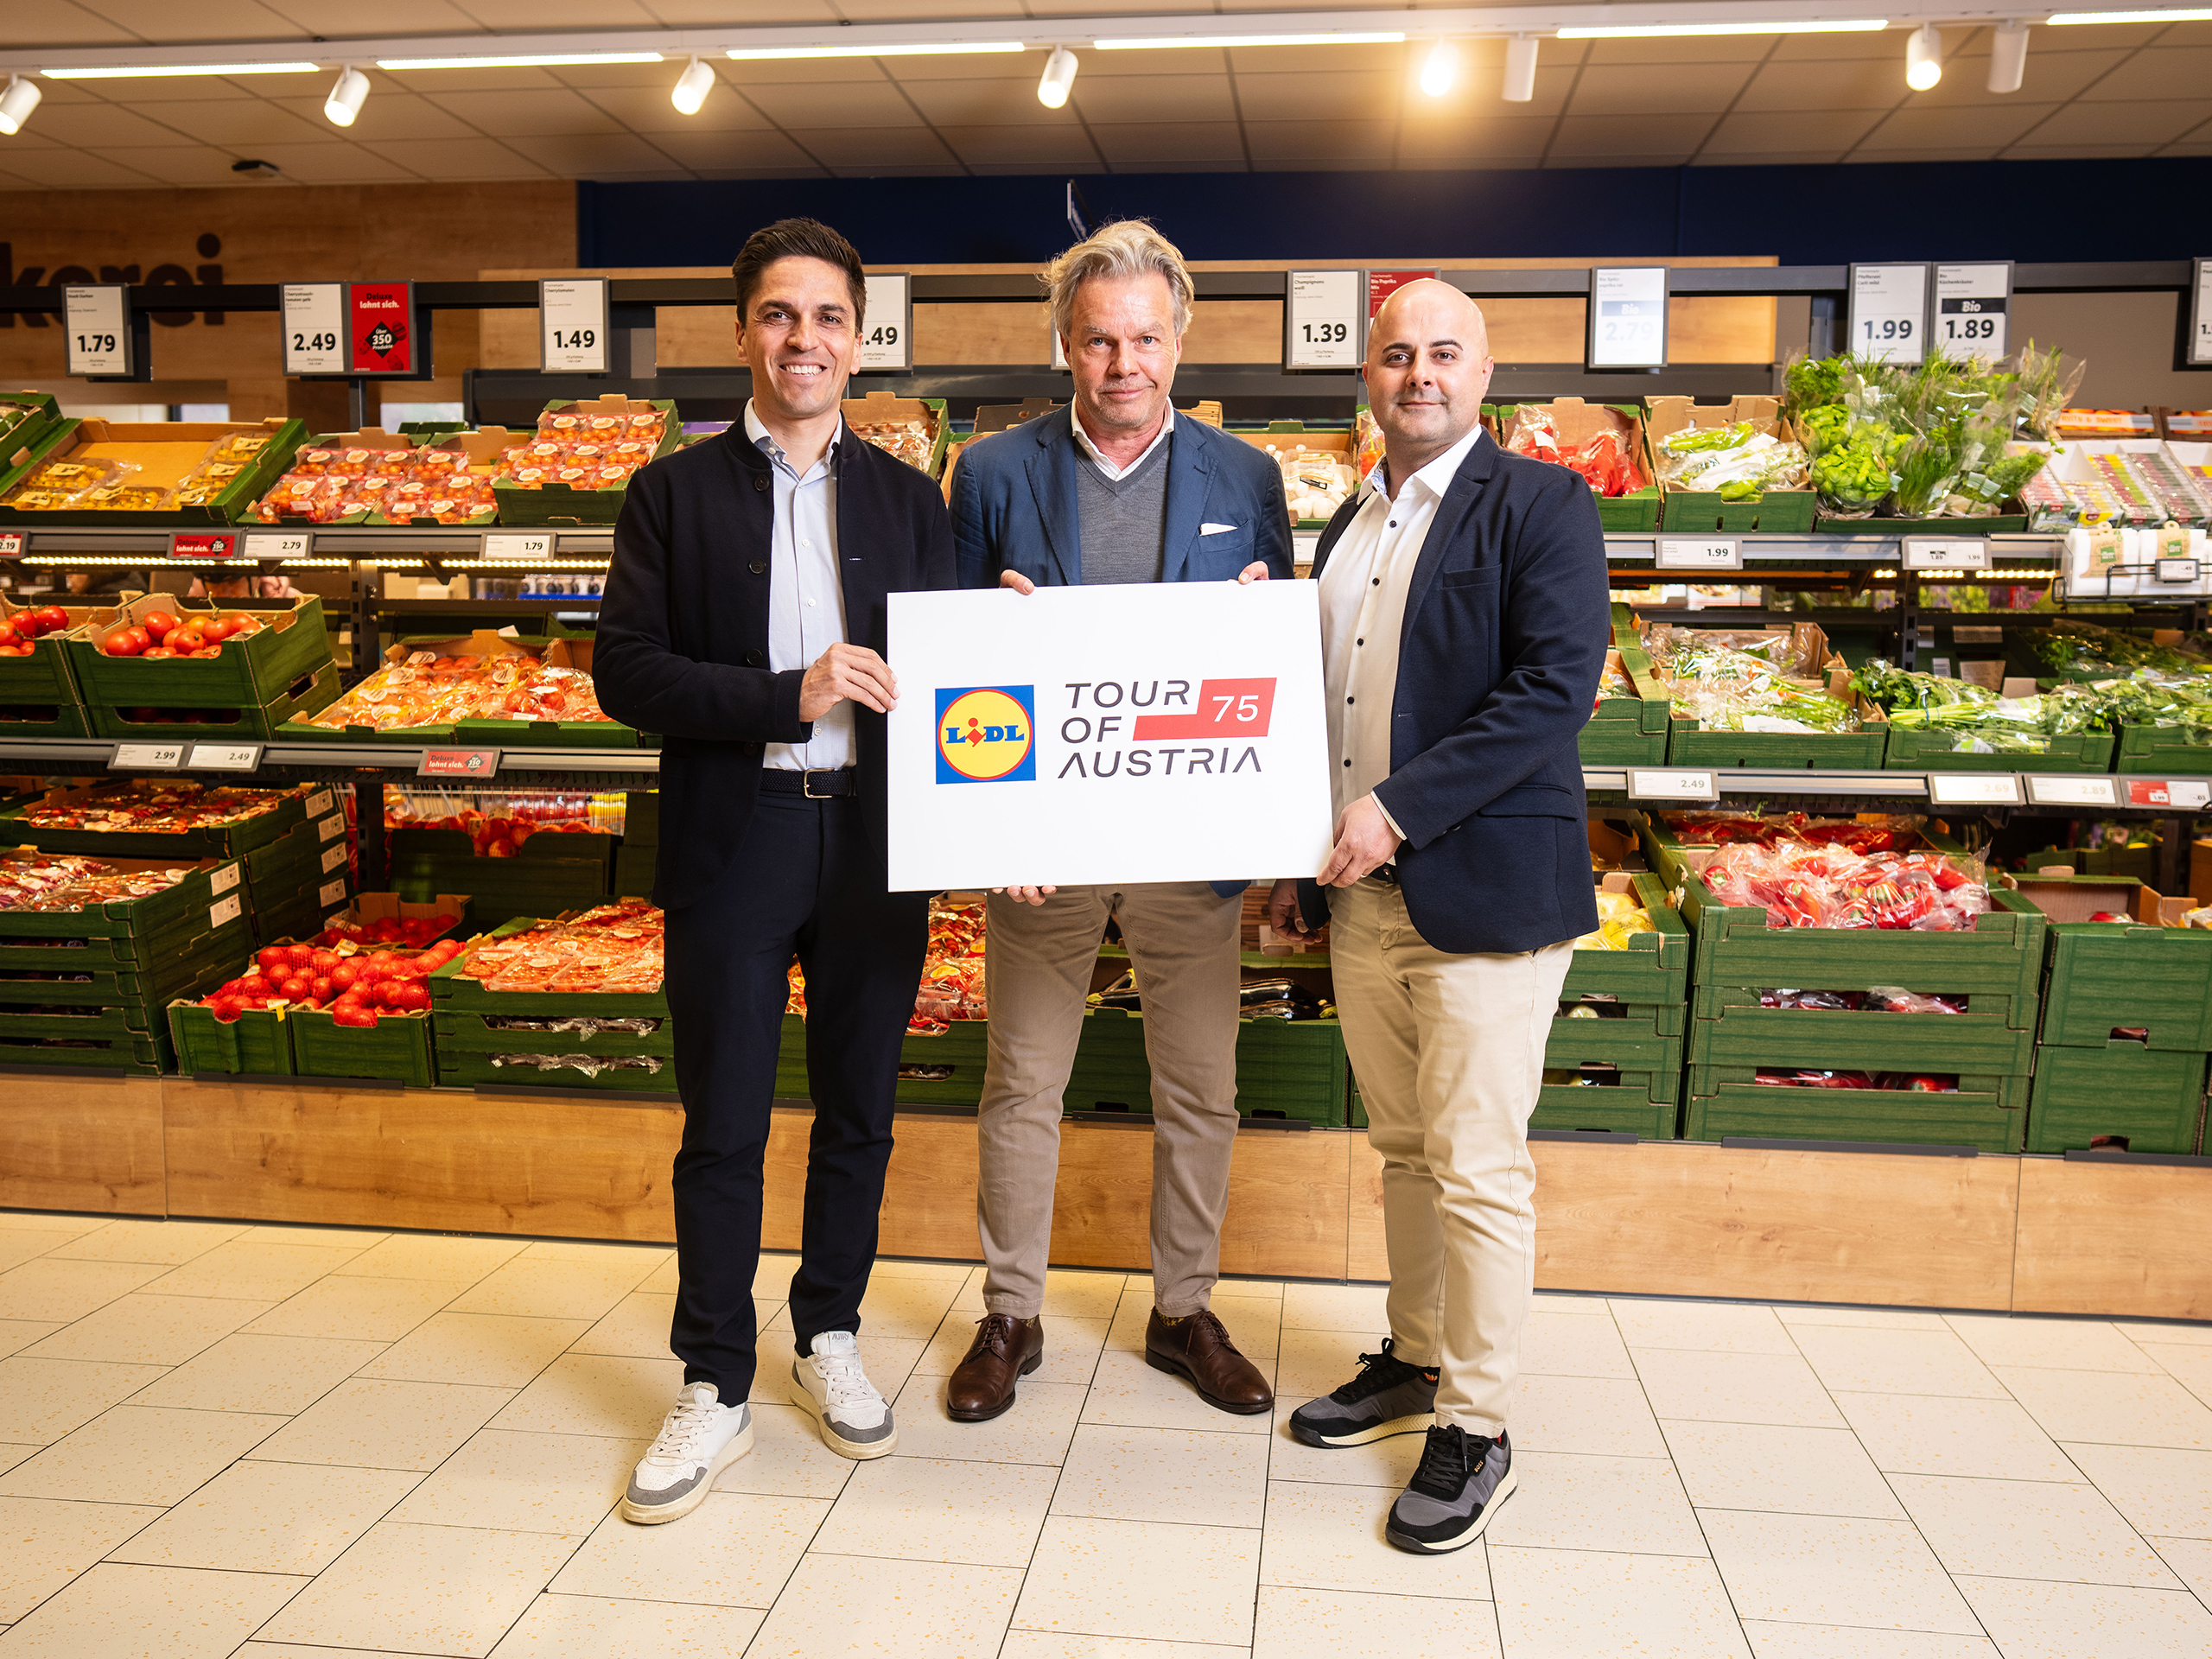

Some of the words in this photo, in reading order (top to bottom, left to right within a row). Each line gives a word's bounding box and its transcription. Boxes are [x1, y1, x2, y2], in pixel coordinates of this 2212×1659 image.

[359, 301, 380, 309] lohnt
[382, 300, 400, 308] sich.
[1621, 303, 1640, 315] Bio
[1961, 300, 1981, 313] Bio
[861, 327, 898, 346] .49
[1303, 323, 1347, 343] 1.39
[1605, 321, 1654, 341] 2.79
[1864, 320, 1913, 340] 1.99
[1946, 319, 1995, 339] 1.89
[77, 334, 116, 353] 1.79
[293, 333, 336, 351] 2.49
[372, 334, 392, 345] 350
[553, 330, 595, 348] 1.49
[524, 542, 543, 550] 1.79
[1707, 548, 1729, 557] 1.99
[1065, 680, 1191, 709] TOUR
[1211, 695, 1259, 722] 75
[1061, 716, 1122, 744] OF
[1058, 747, 1262, 779] AUSTRIA
[1681, 779, 1705, 788] 2.49
[1984, 784, 2010, 793] 2.69
[2081, 786, 2107, 795] 2.89
